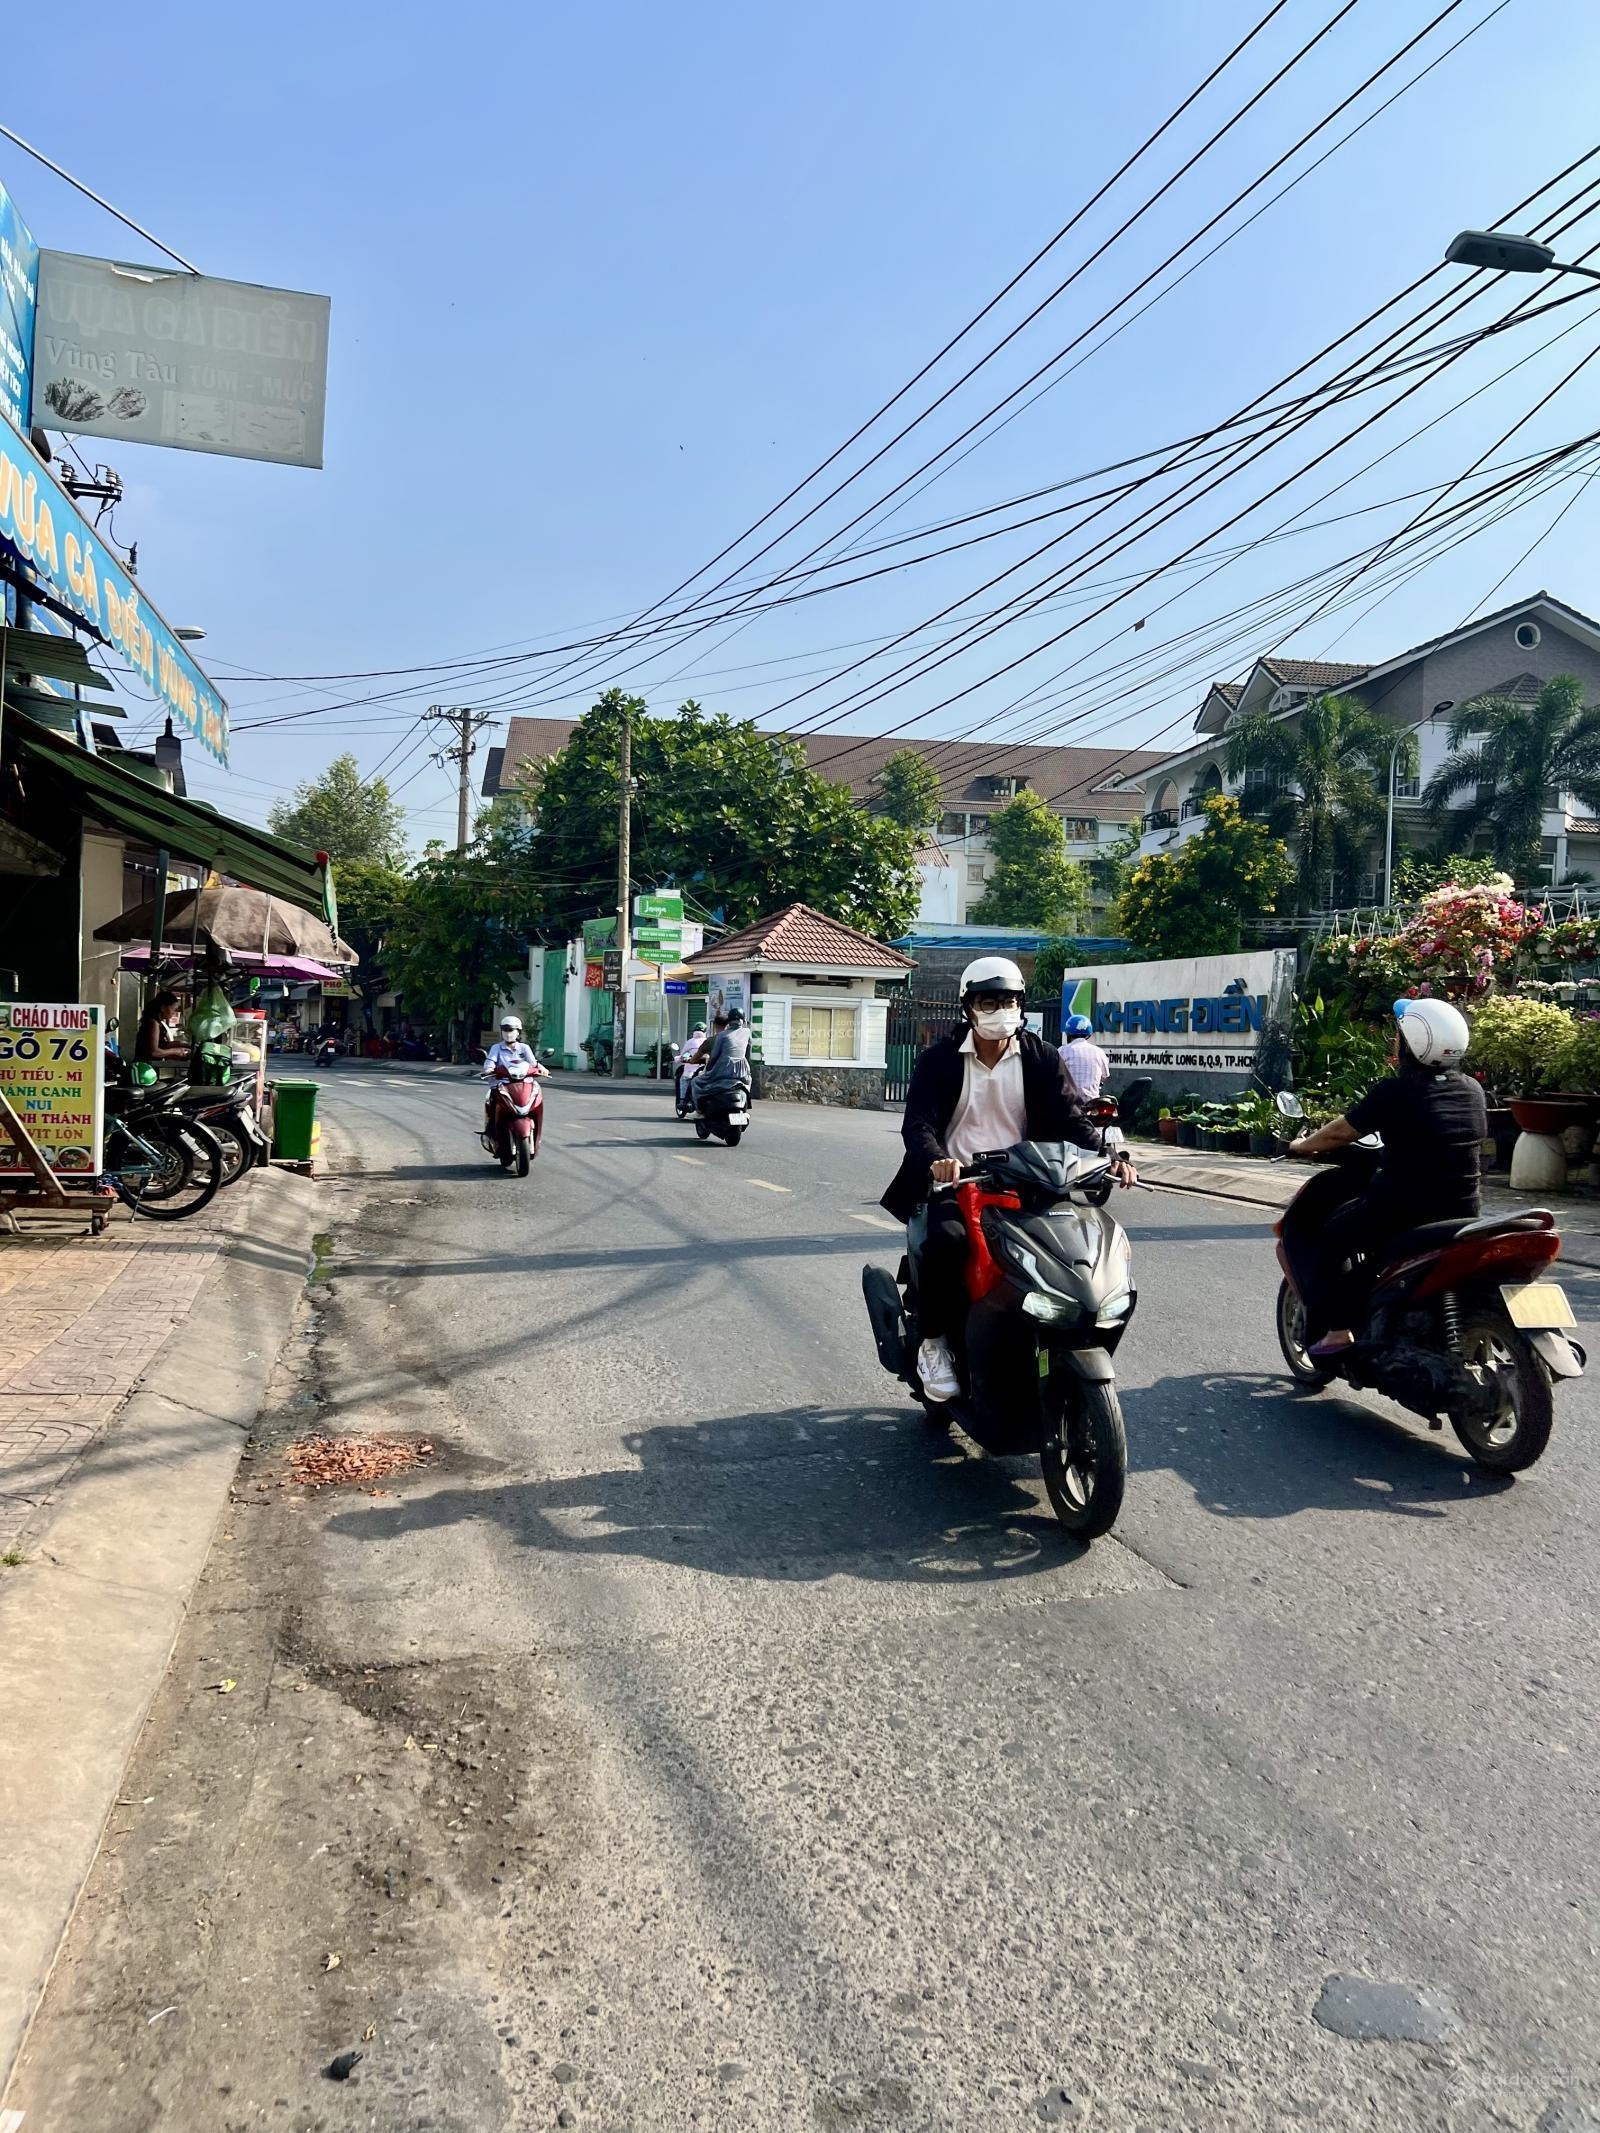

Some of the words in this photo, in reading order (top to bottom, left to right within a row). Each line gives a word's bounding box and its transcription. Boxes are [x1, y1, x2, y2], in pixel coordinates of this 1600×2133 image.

[44, 335, 117, 380] Vũng
[126, 349, 179, 384] Tàu
[65, 532, 100, 619] CÁ
[104, 578, 154, 680] BIỂN
[1094, 998, 1190, 1033] KHANG
[1190, 977, 1267, 1033] ĐIỀN
[13, 1004, 48, 1028] CHÁO
[53, 1005, 88, 1029] LÒNG
[49, 1038, 88, 1061] 76
[1176, 1055, 1197, 1066] LONG
[21, 1066, 55, 1081] TIẾU
[66, 1069, 83, 1081] MÌ
[41, 1086, 82, 1098] CANH
[26, 1100, 52, 1110] NUI
[42, 1110, 92, 1125] THÁNH
[55, 1126, 83, 1142] LỘN
